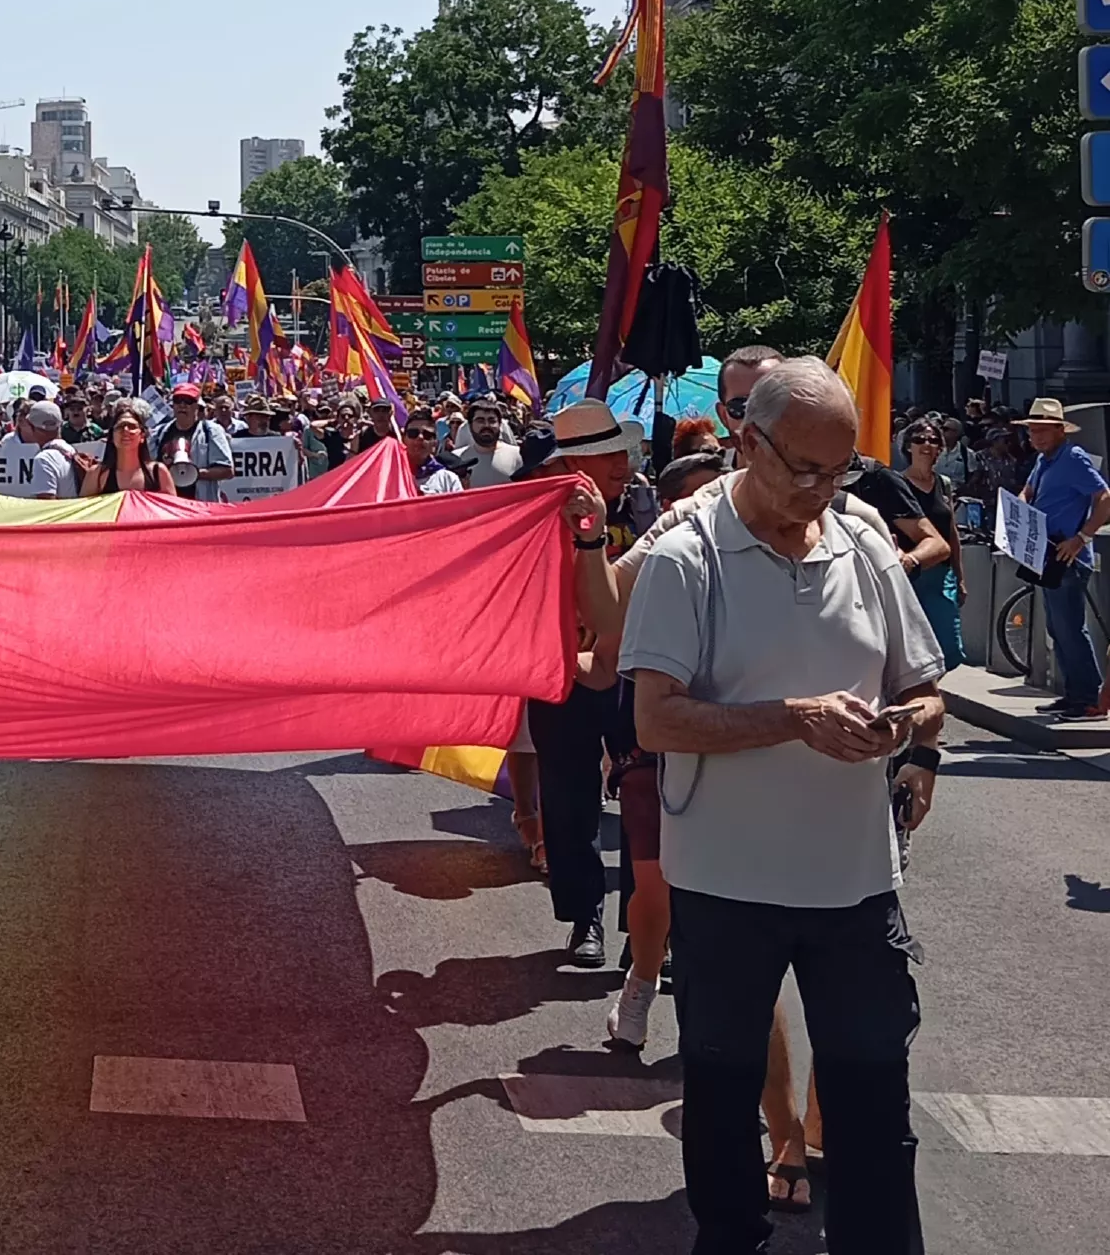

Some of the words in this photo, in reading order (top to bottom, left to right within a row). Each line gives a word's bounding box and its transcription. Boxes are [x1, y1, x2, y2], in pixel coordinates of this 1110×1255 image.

[425, 248, 492, 256] Independencia
[426, 267, 456, 275] Palacio
[460, 267, 470, 275] de
[495, 299, 521, 307] Coln
[232, 451, 288, 477] ERRA
